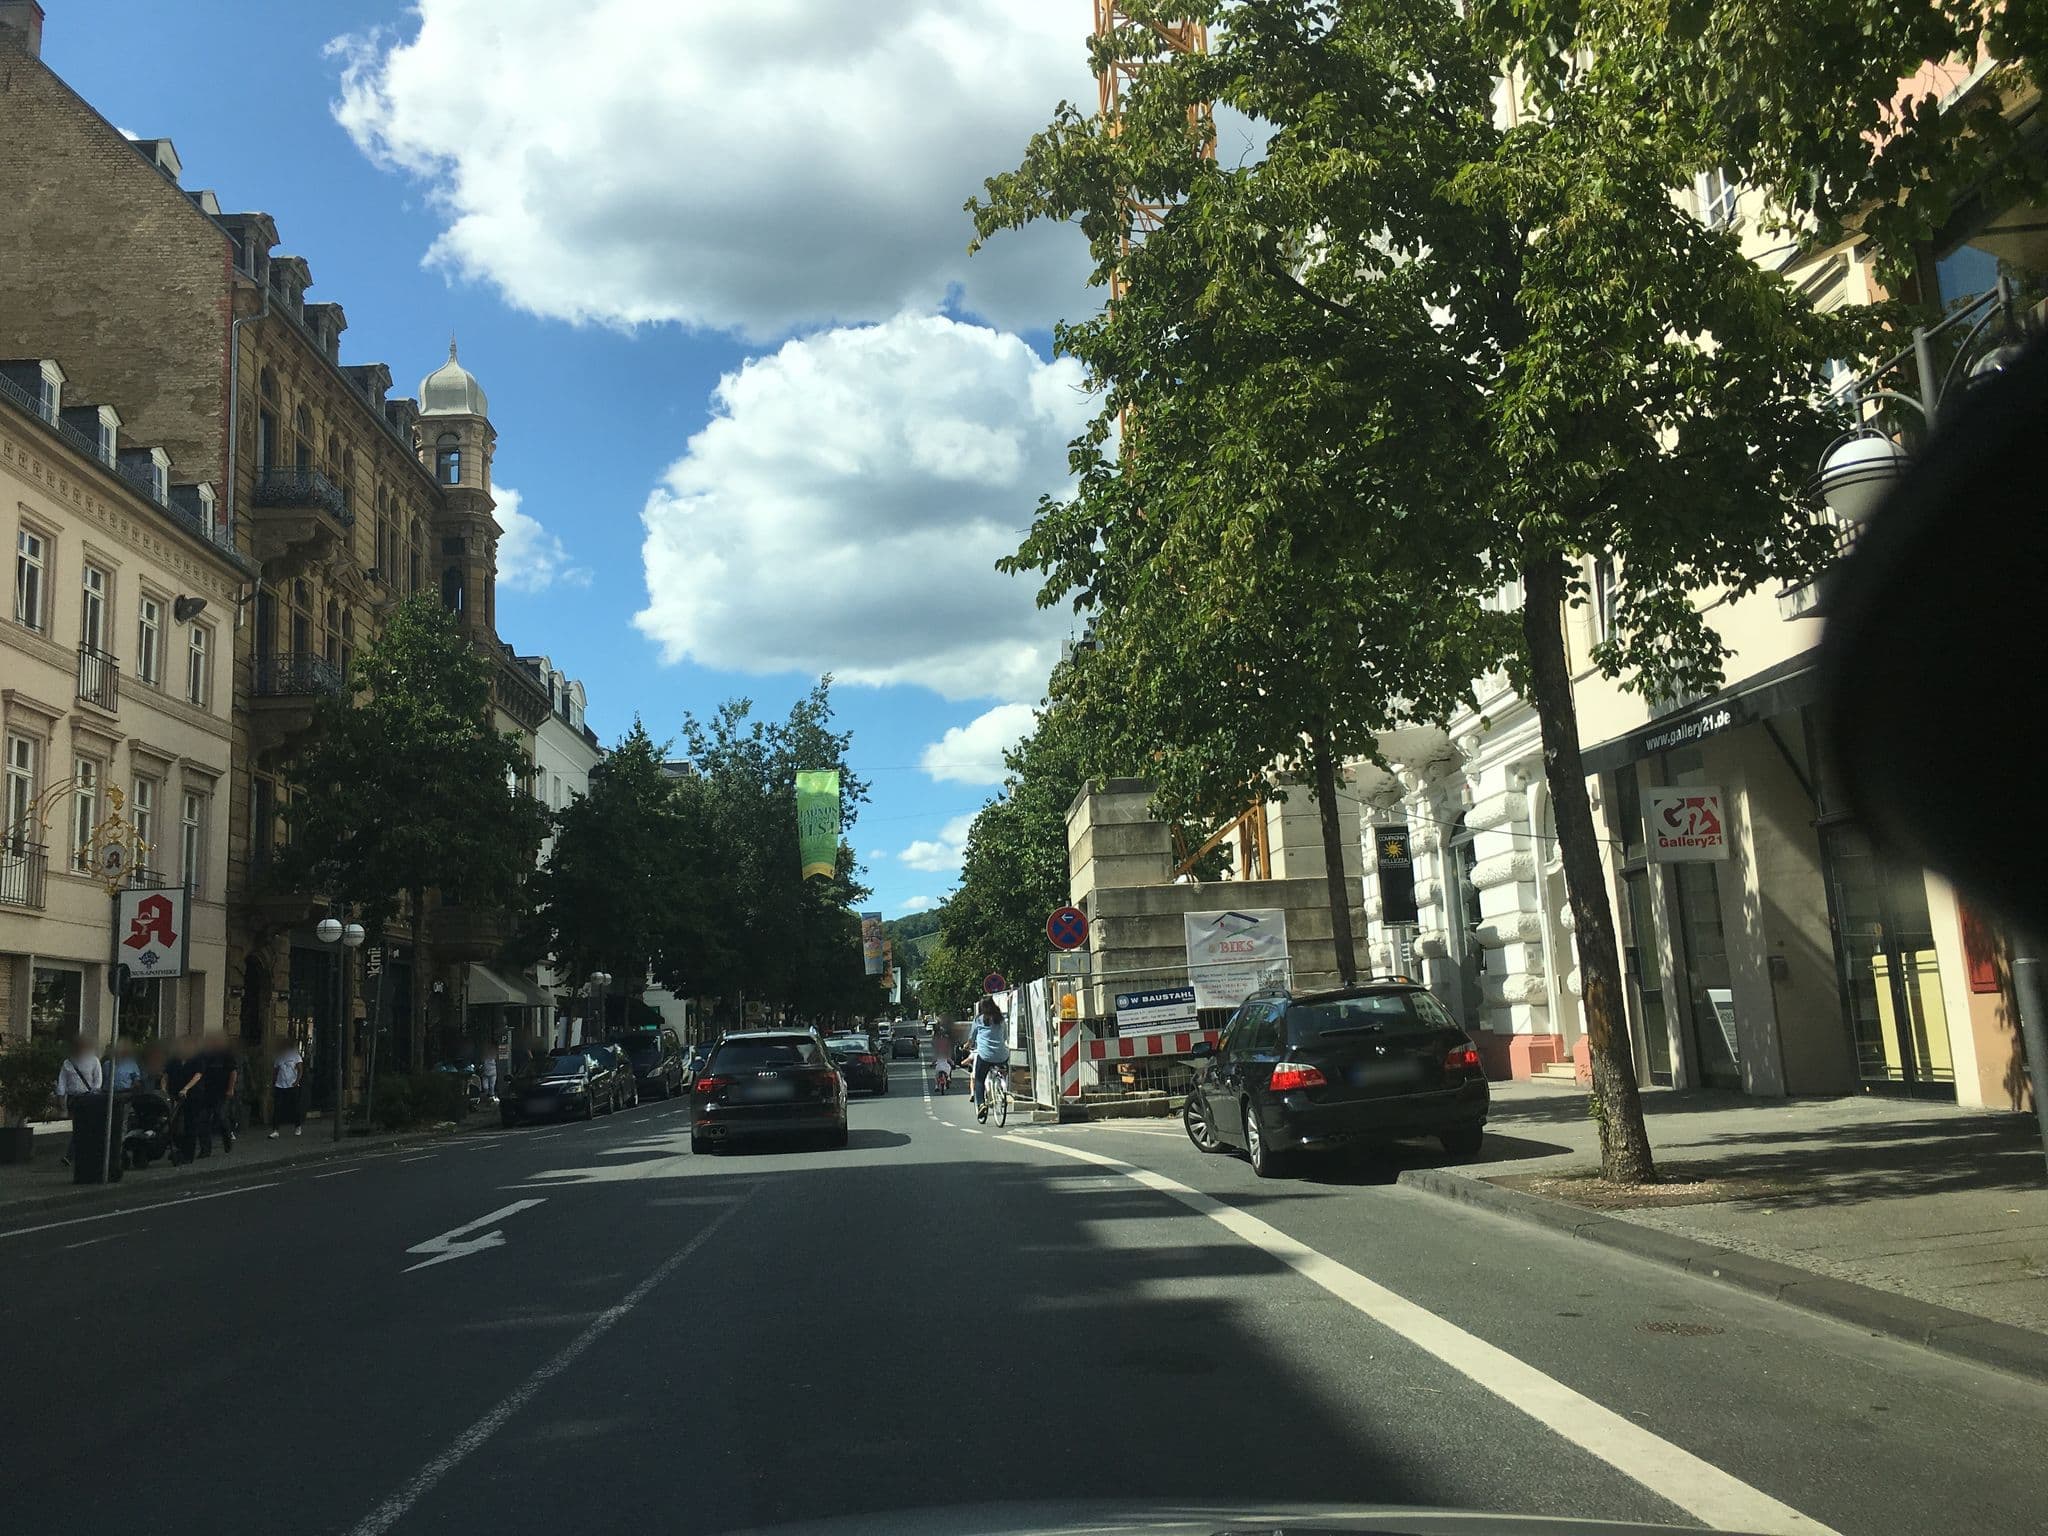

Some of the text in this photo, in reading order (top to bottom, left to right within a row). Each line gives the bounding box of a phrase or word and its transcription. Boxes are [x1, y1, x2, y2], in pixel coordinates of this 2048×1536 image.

[1646, 710, 1731, 751] www.gallery21.de
[1659, 836, 1723, 848] Gallery21
[1220, 940, 1254, 953] BIKS
[1142, 991, 1194, 1003] BAUSTAHL
